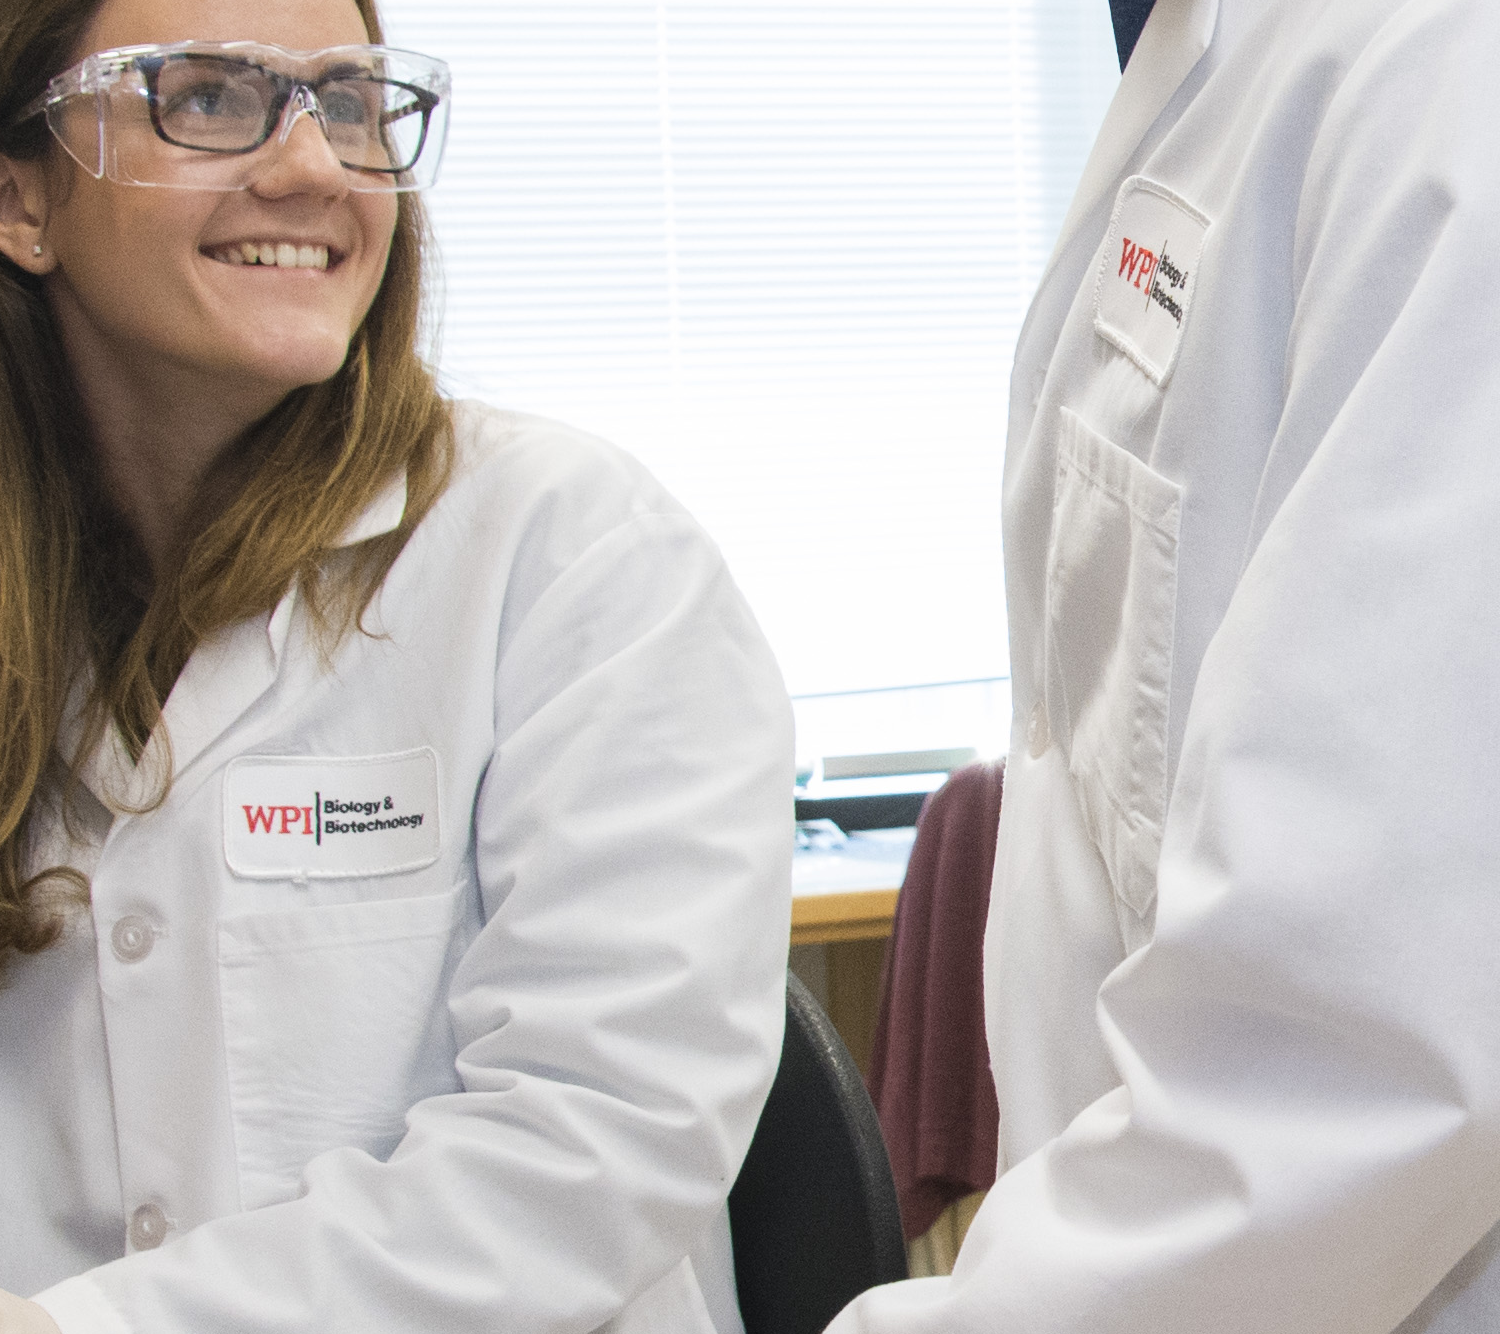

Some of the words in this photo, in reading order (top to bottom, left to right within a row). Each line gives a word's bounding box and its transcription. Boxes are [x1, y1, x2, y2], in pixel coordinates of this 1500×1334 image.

[1118, 237, 1160, 296] WPI
[242, 804, 314, 835] WPI
[324, 799, 382, 816] Biology
[383, 796, 394, 810] &
[324, 812, 425, 835] Biotechnology
